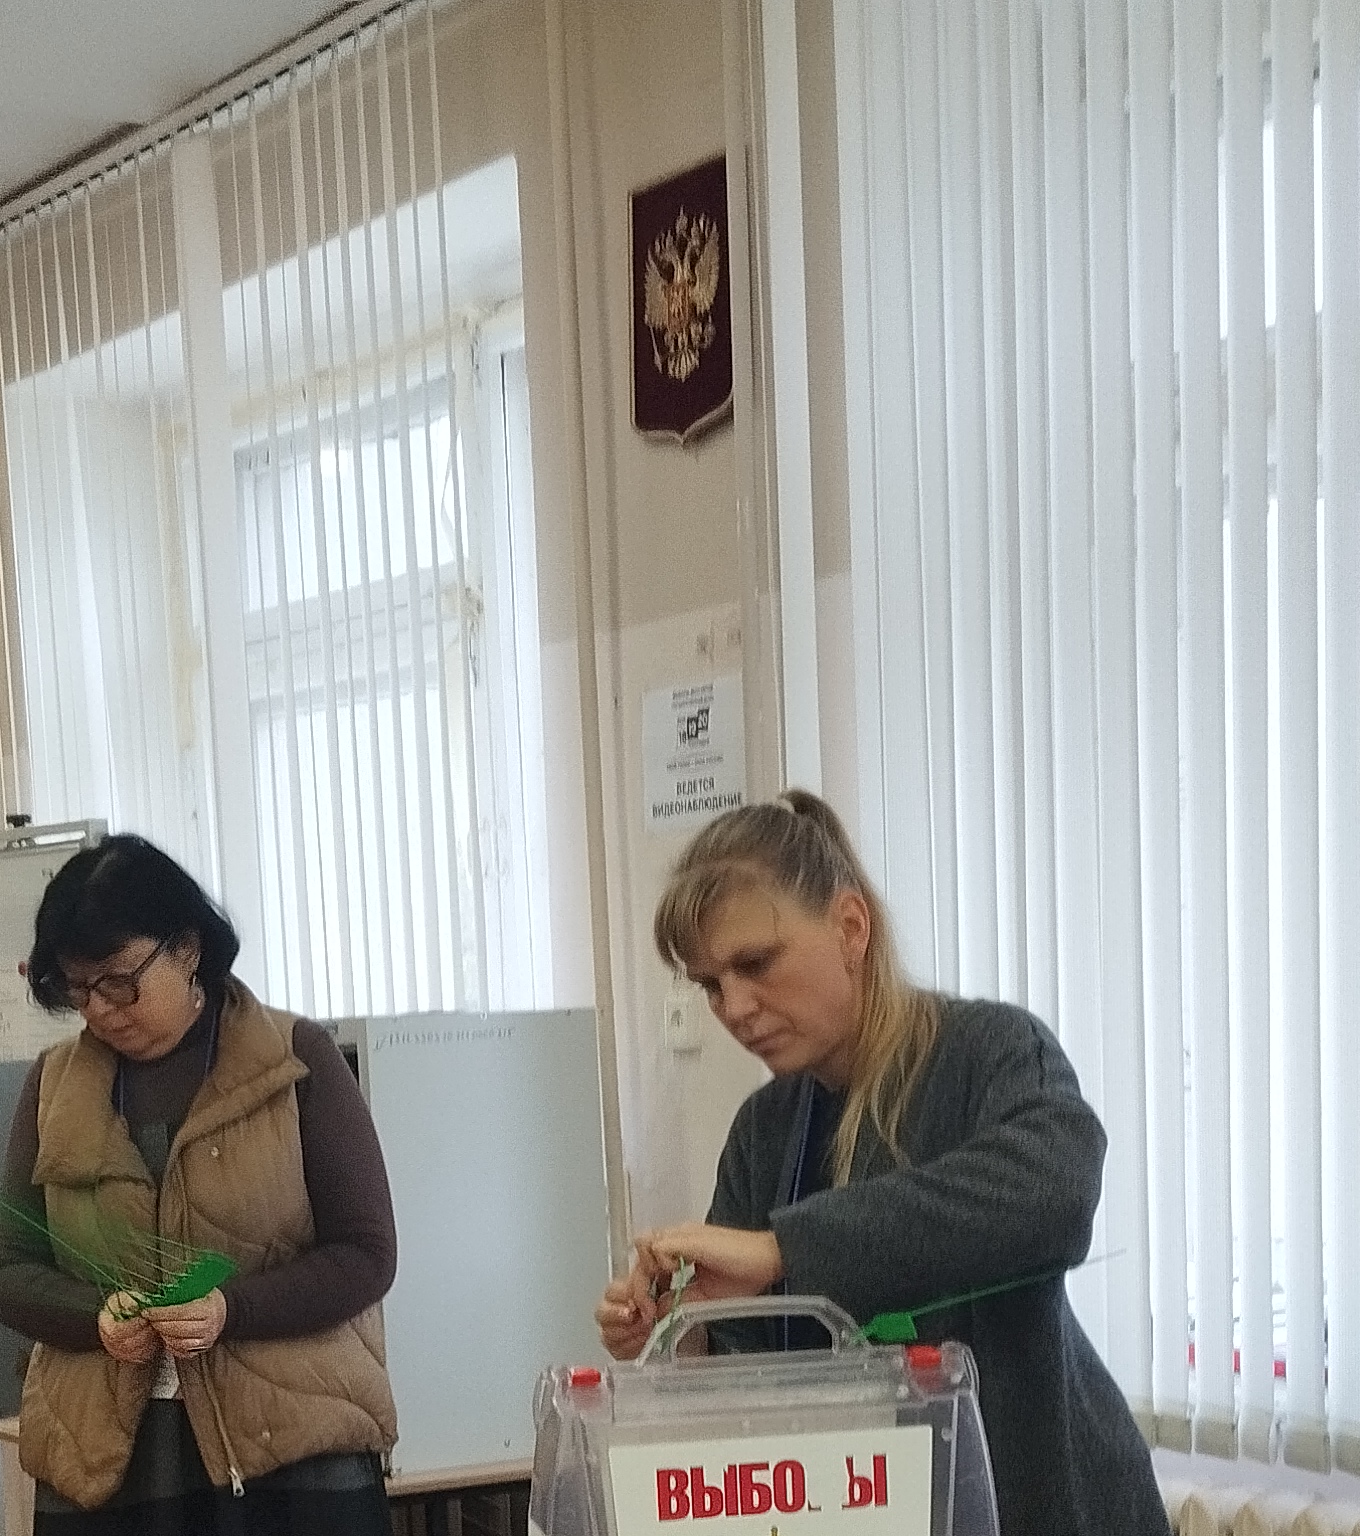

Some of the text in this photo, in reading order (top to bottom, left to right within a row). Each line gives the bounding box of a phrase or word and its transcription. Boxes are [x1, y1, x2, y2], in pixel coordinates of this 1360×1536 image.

[676, 777, 715, 796] ВЕДЕТСЯ
[652, 792, 741, 818] ВИДЕОНАБЛЮДЕНИЕ
[656, 1453, 889, 1522] ВЫБОЫ
